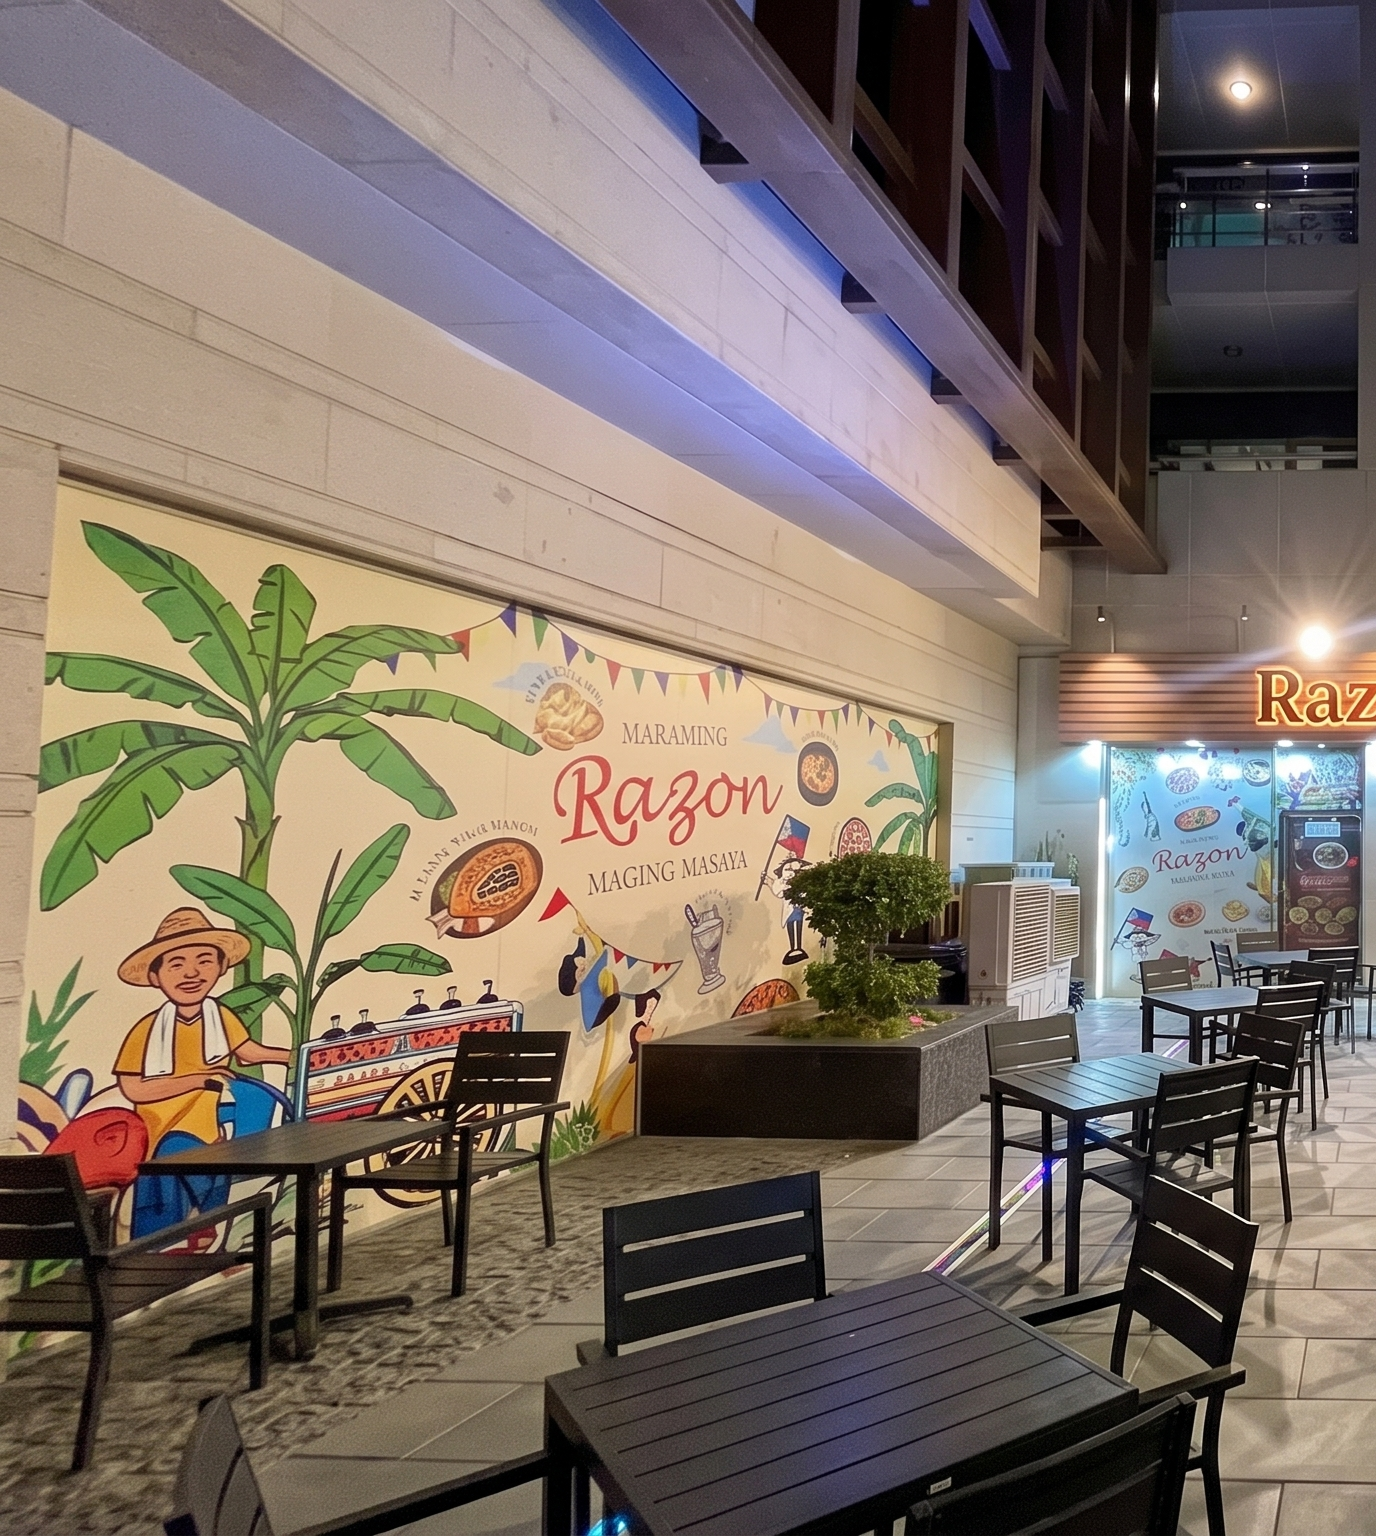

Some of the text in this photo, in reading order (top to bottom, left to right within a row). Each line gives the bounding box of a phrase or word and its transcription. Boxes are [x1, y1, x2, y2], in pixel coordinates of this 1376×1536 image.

[622, 722, 728, 747] MARAMING
[553, 755, 784, 847] Razon
[587, 850, 748, 896] MAGING MASAYA
[1152, 846, 1249, 874] Razon
